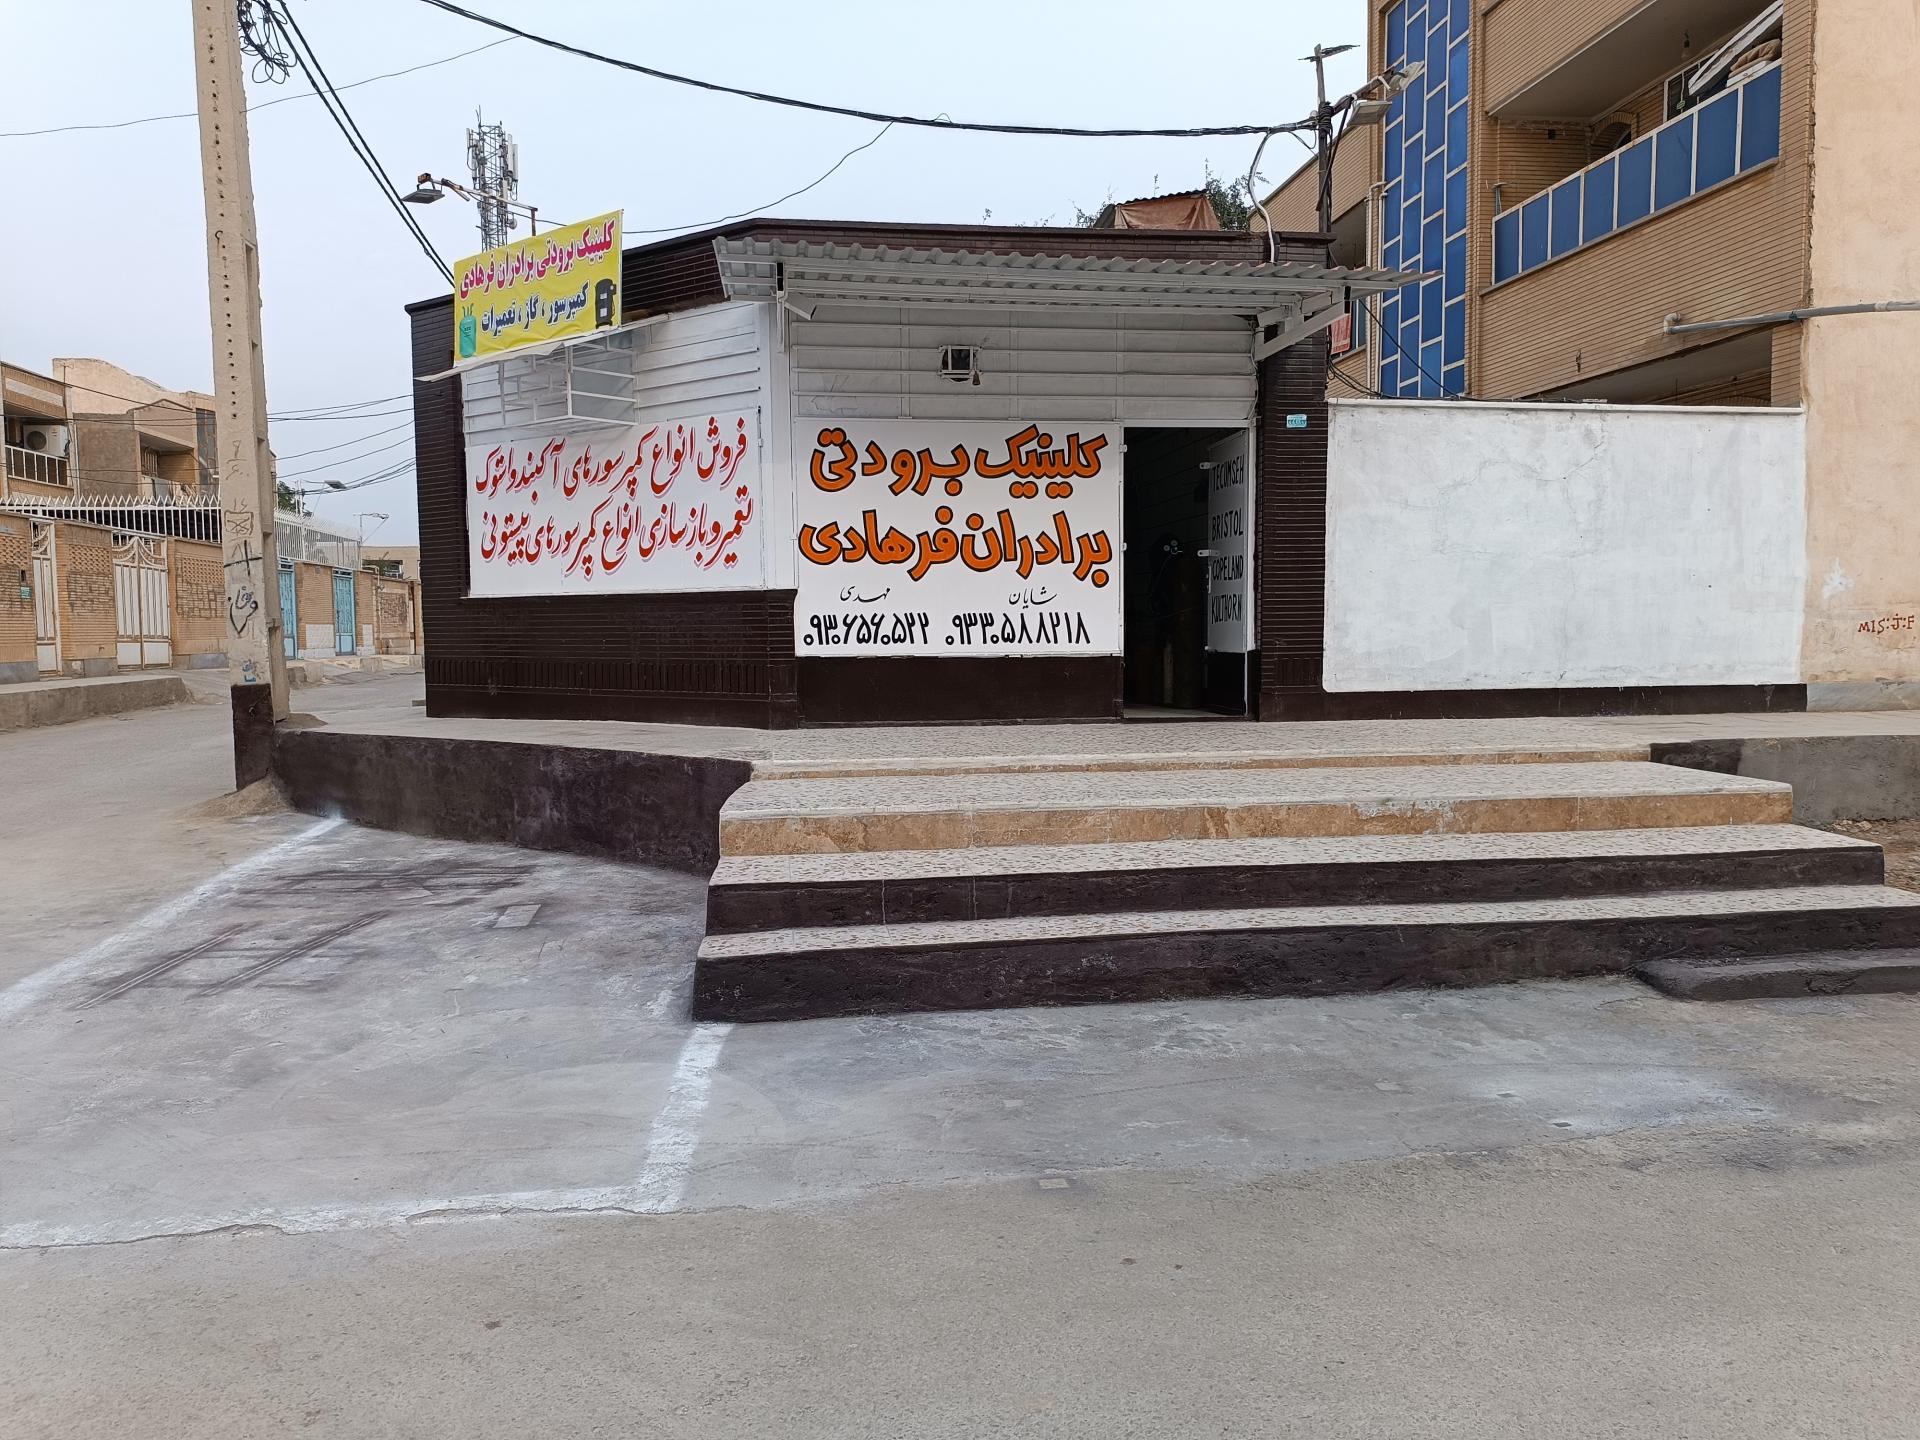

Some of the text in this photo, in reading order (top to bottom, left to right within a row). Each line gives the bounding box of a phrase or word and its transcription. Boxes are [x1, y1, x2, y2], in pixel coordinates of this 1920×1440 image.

[460, 219, 615, 299] کلینیک برودتی برادران فرهادی
[650, 425, 696, 495] انواع
[697, 416, 748, 486] فروش
[809, 424, 1108, 499] کلینیک برودتی
[1212, 454, 1245, 491] TECUMSEH
[481, 510, 529, 563] پیستونی
[600, 503, 641, 571] انواع
[704, 485, 752, 567] تعمیر
[798, 506, 1112, 588] برادران فرهادی
[1212, 508, 1244, 541] BRISTOL
[840, 585, 891, 603] مهدی
[1008, 586, 1057, 609] شایان
[1212, 555, 1244, 581] COPELAND
